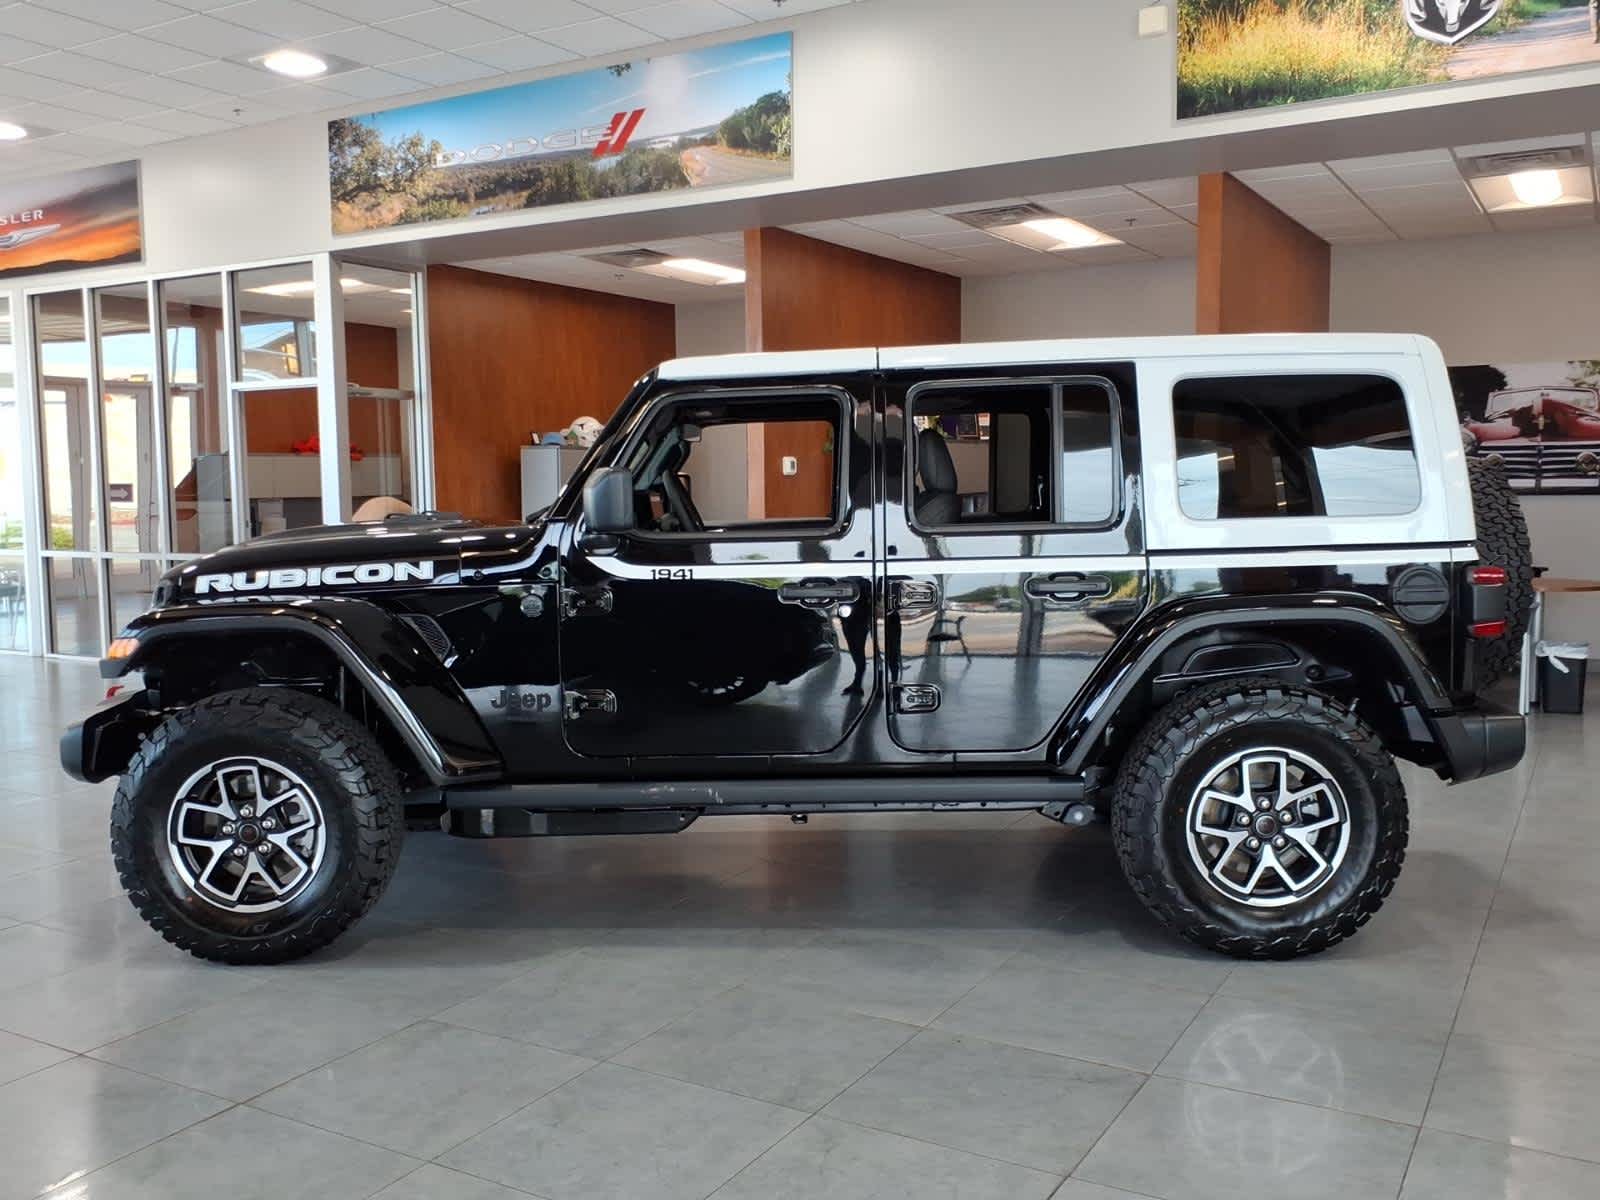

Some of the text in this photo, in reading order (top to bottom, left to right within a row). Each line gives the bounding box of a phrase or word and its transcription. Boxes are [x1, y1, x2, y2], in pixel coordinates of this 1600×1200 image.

[194, 560, 434, 594] RUBICON
[650, 568, 693, 580] 1941
[490, 687, 552, 712] Jeep
